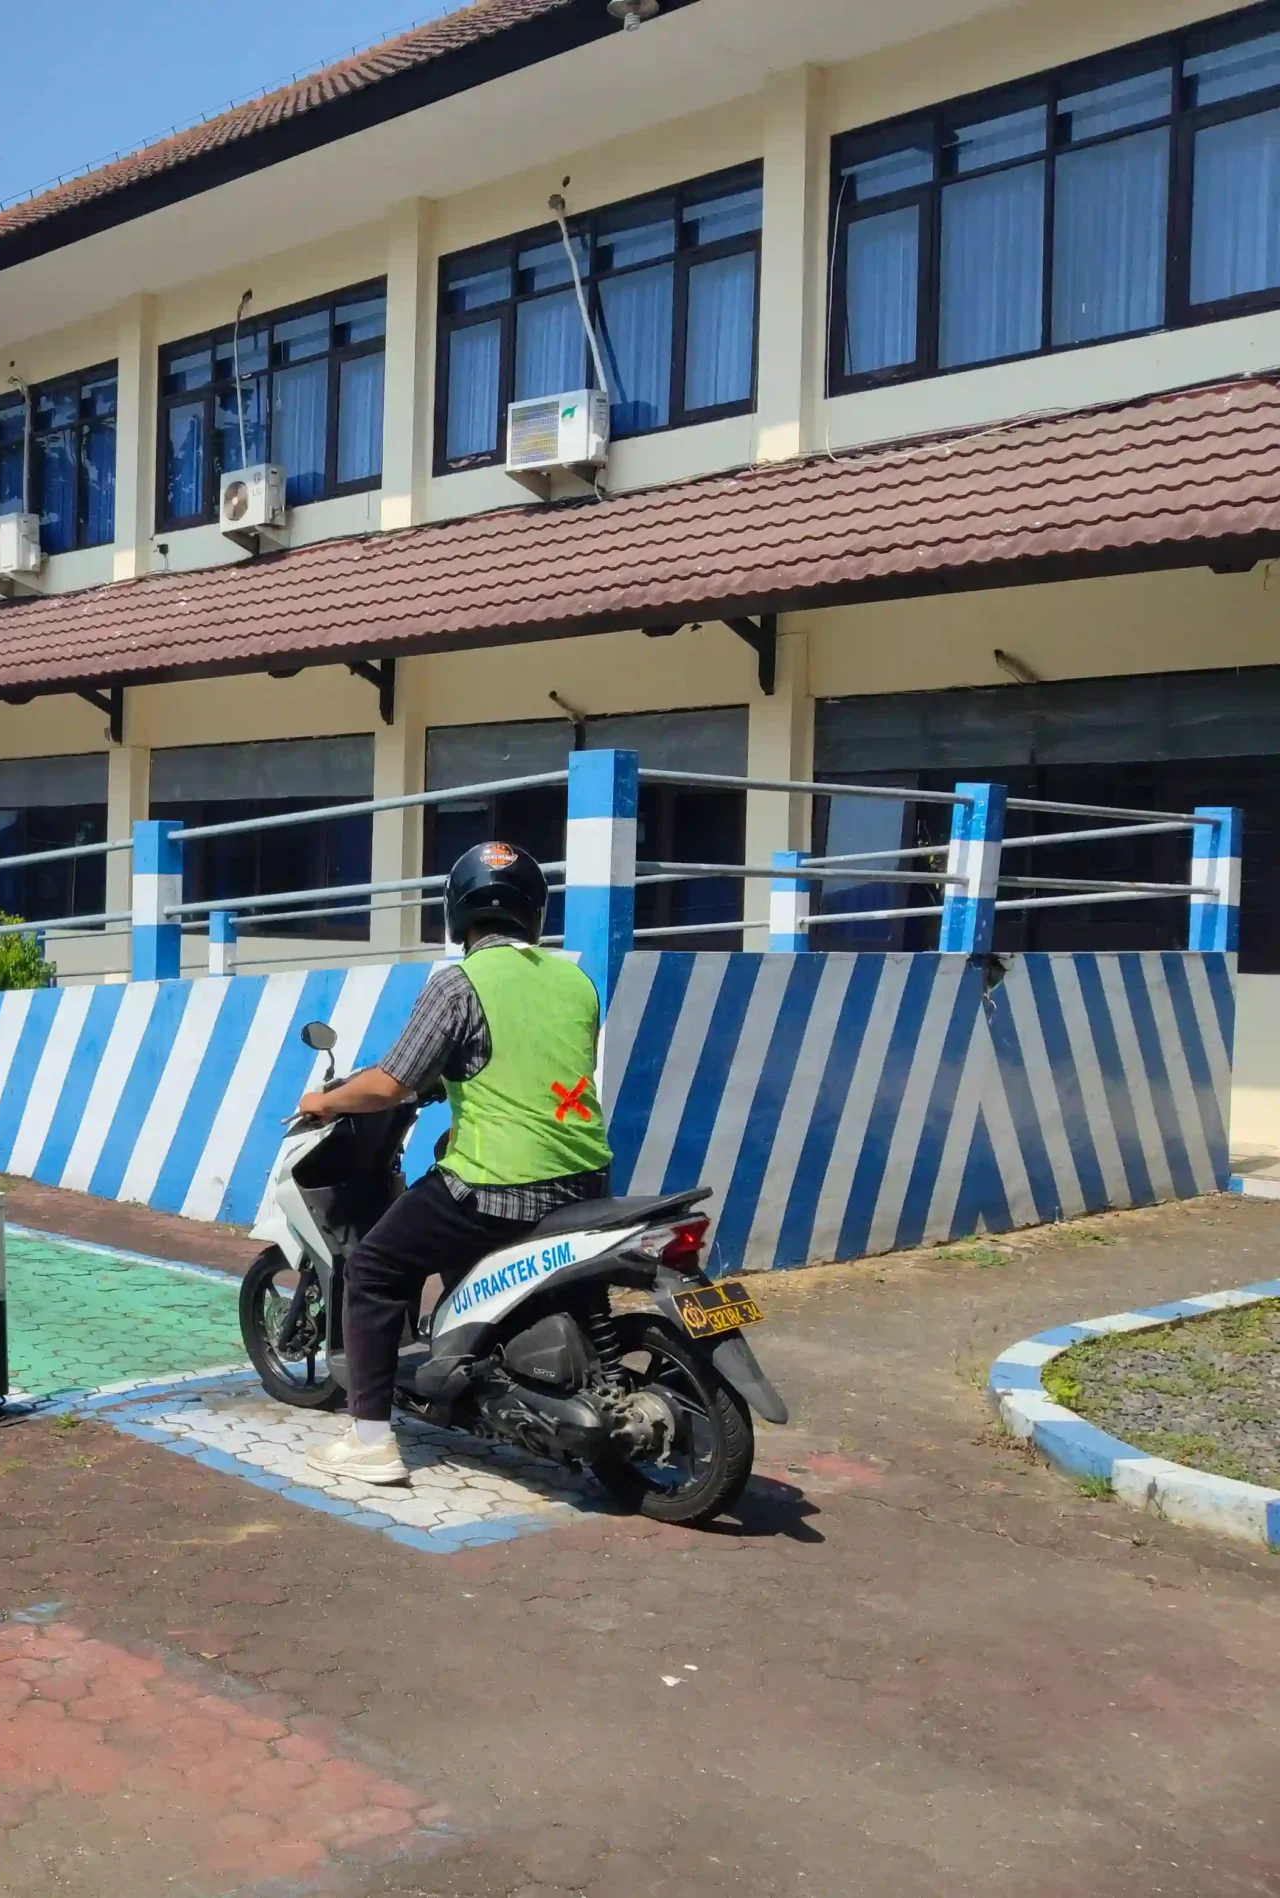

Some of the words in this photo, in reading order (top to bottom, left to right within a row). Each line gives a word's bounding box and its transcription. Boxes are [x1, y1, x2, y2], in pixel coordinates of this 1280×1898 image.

[452, 1287, 473, 1314] UJI
[473, 1255, 539, 1302] PRAKTEK
[542, 1241, 576, 1271] SIM.
[715, 1286, 731, 1303] X
